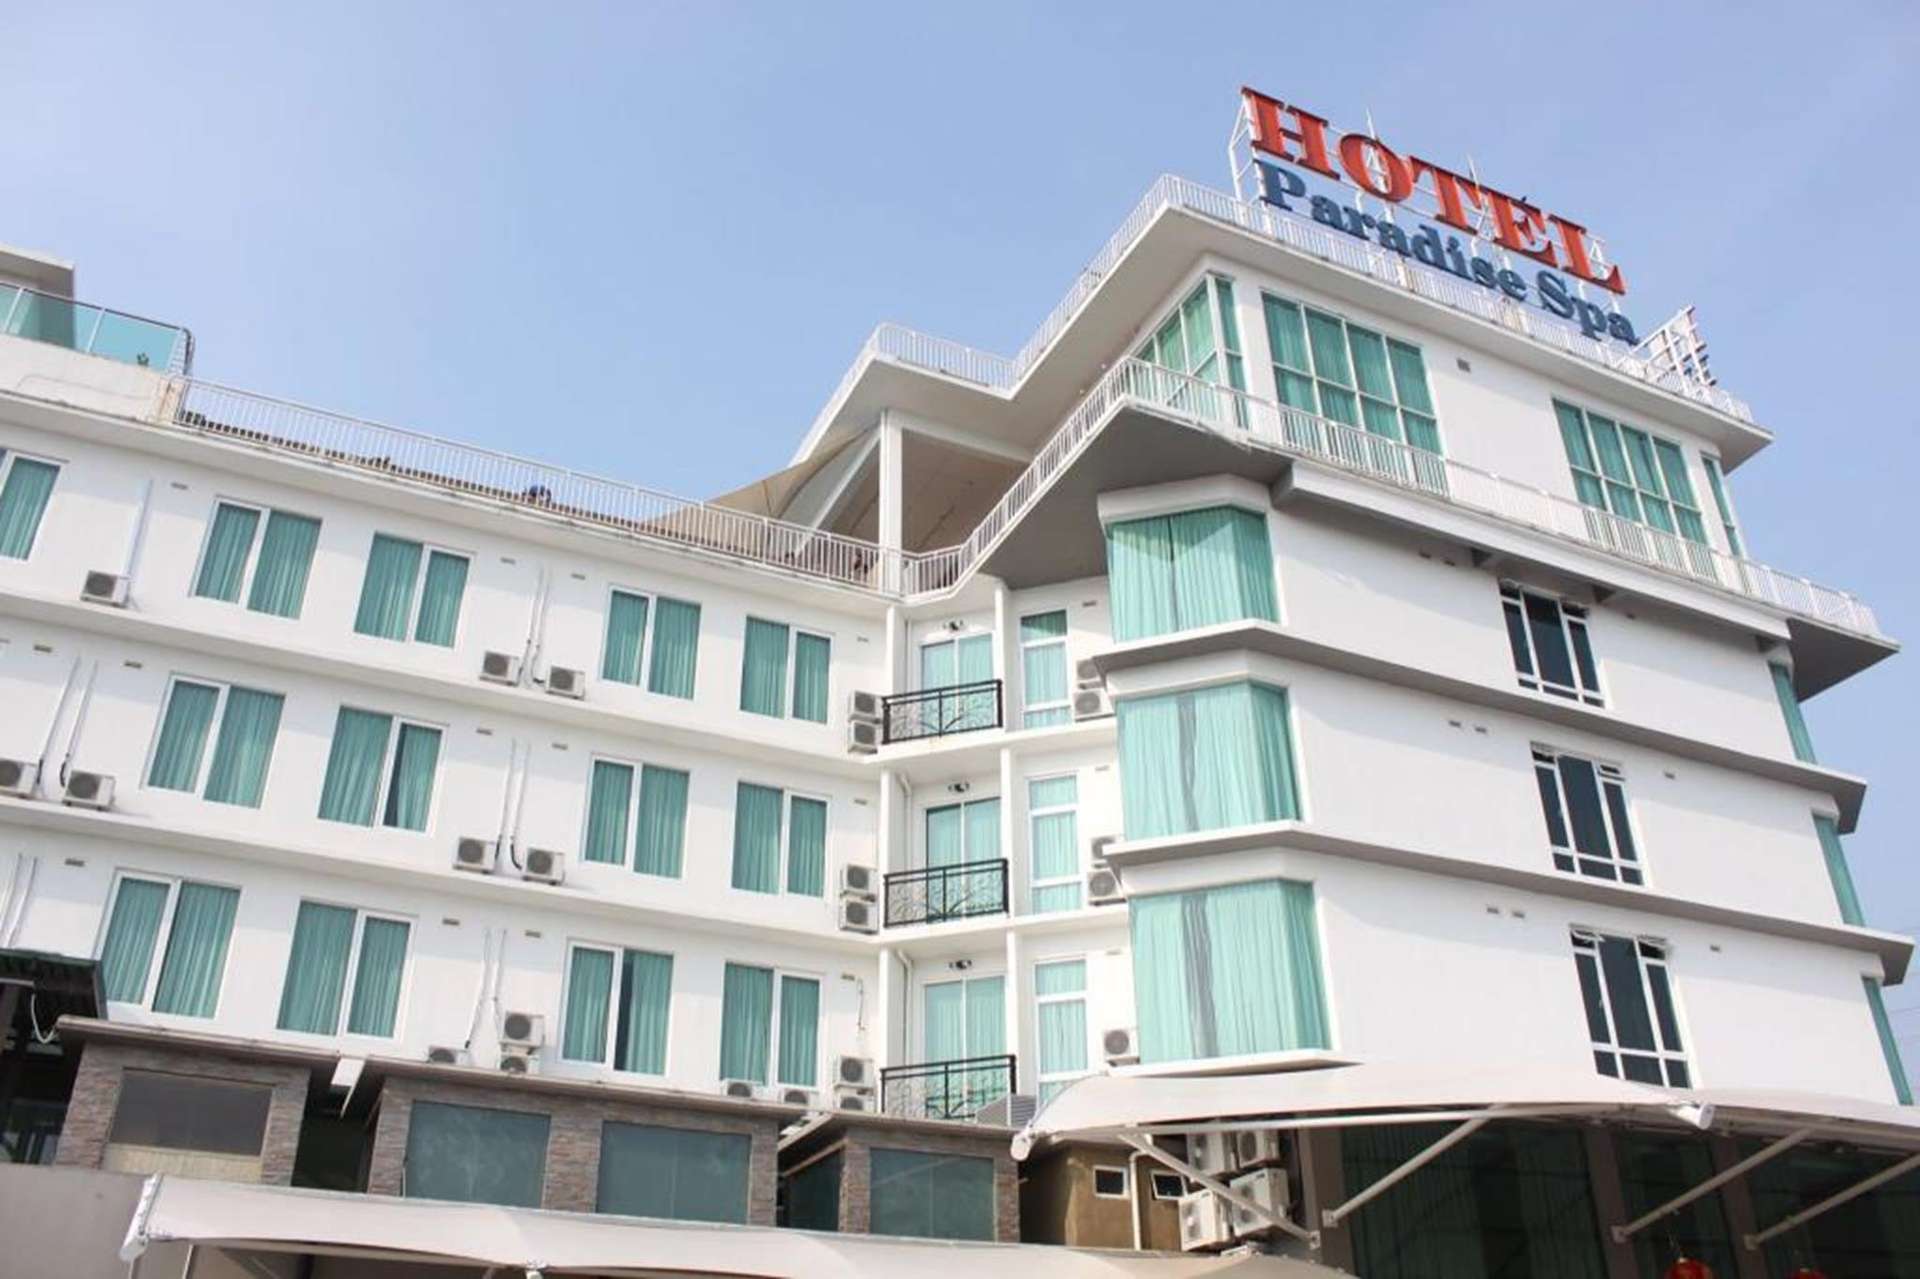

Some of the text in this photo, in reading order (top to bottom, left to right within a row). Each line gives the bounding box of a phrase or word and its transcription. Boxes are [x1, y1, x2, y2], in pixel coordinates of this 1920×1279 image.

[1241, 86, 1626, 295] HOTEL
[1254, 160, 1639, 345] Paradise Spa
